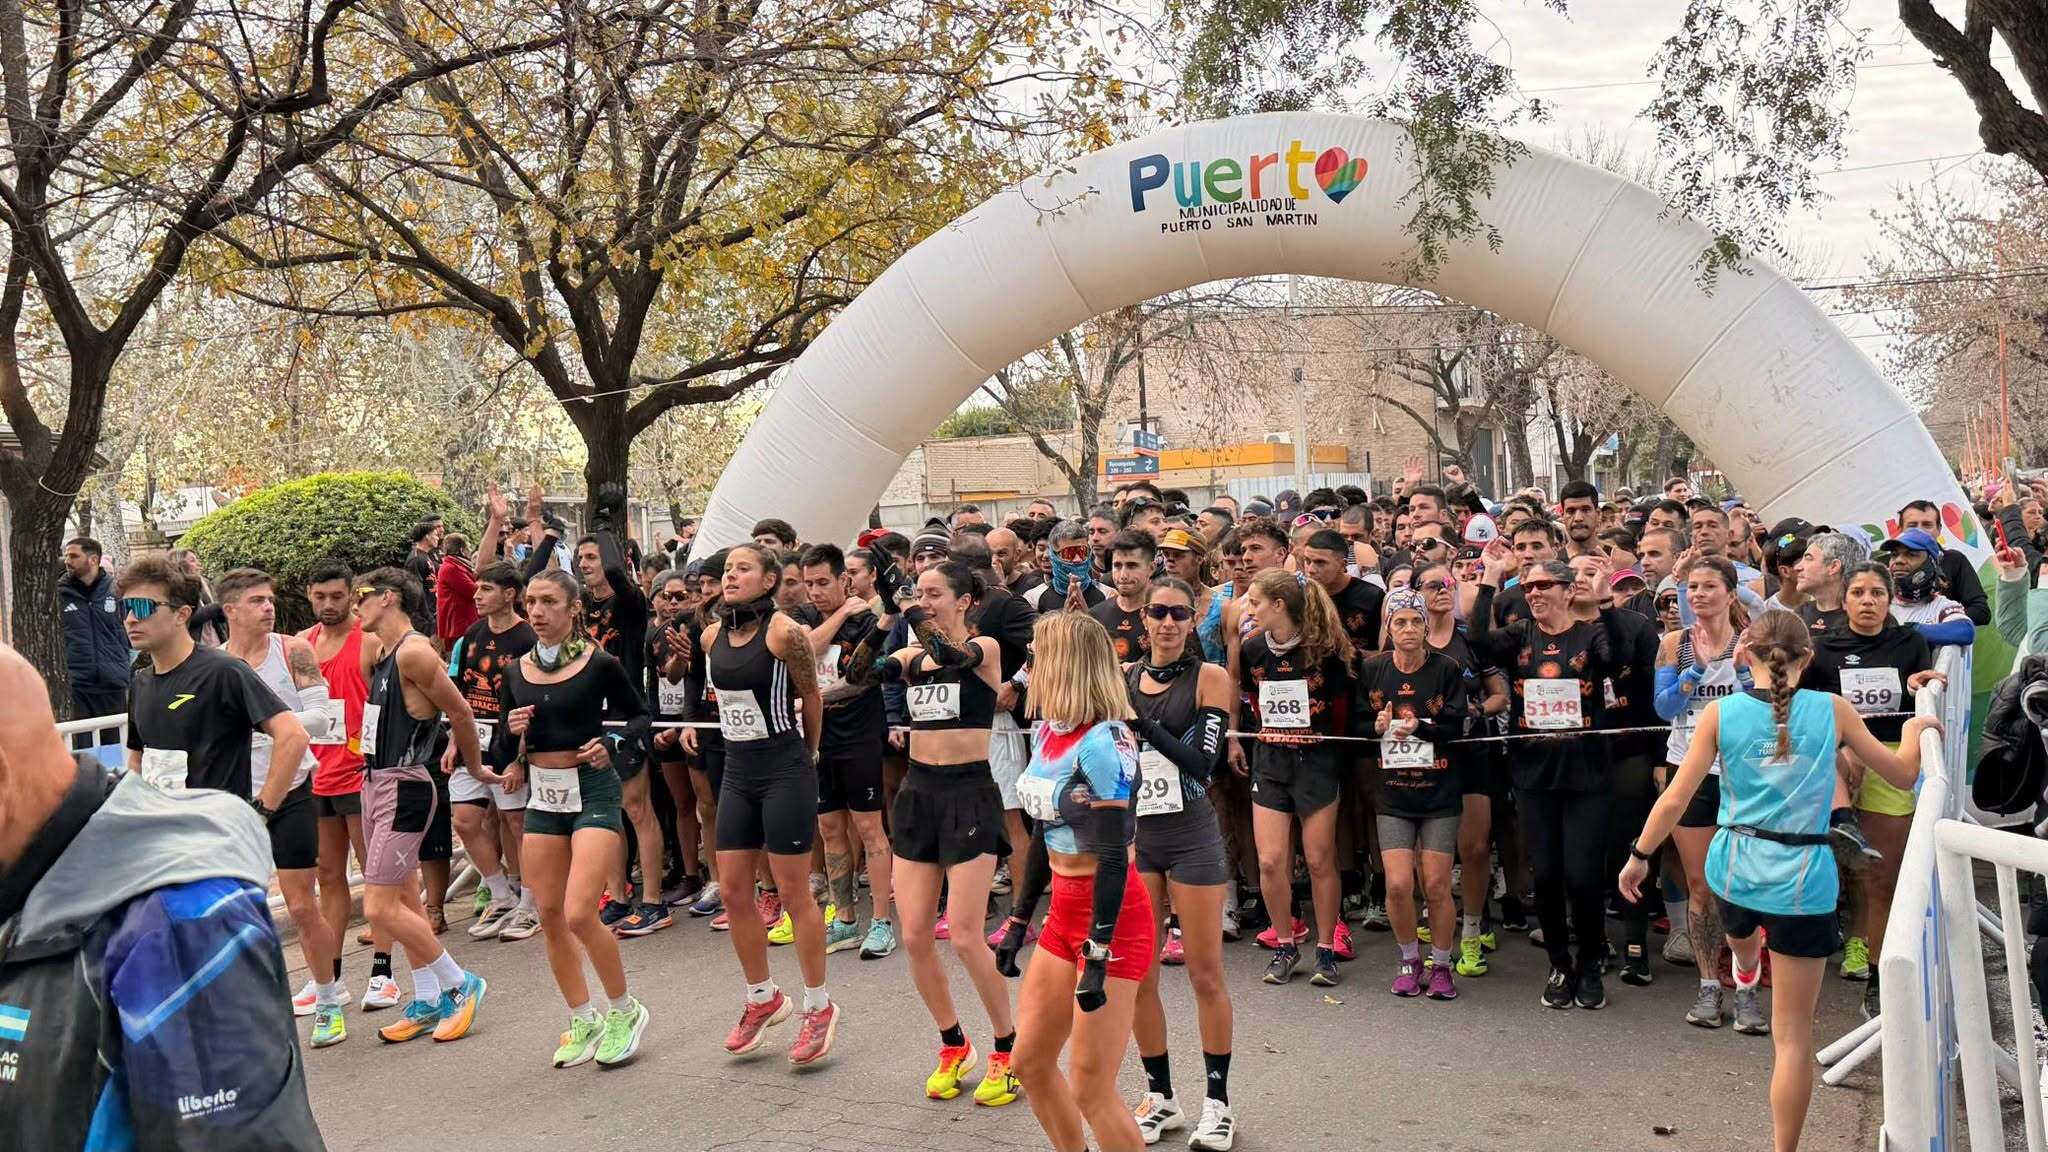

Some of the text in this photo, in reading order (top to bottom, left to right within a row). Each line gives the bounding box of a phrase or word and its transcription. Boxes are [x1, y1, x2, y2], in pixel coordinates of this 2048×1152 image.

[1180, 198, 1297, 219] MUNICIPALIDAD DE
[1161, 213, 1318, 233] PUERTO SAN MARTIN
[914, 684, 949, 705] 270
[1851, 688, 1892, 705] 369
[1266, 700, 1301, 714] 268
[1526, 700, 1578, 717] 5148
[723, 708, 755, 727] 186
[1388, 741, 1422, 755] 267
[537, 787, 569, 805] 187
[1137, 777, 1169, 800] 39
[178, 1087, 237, 1114] liberto
